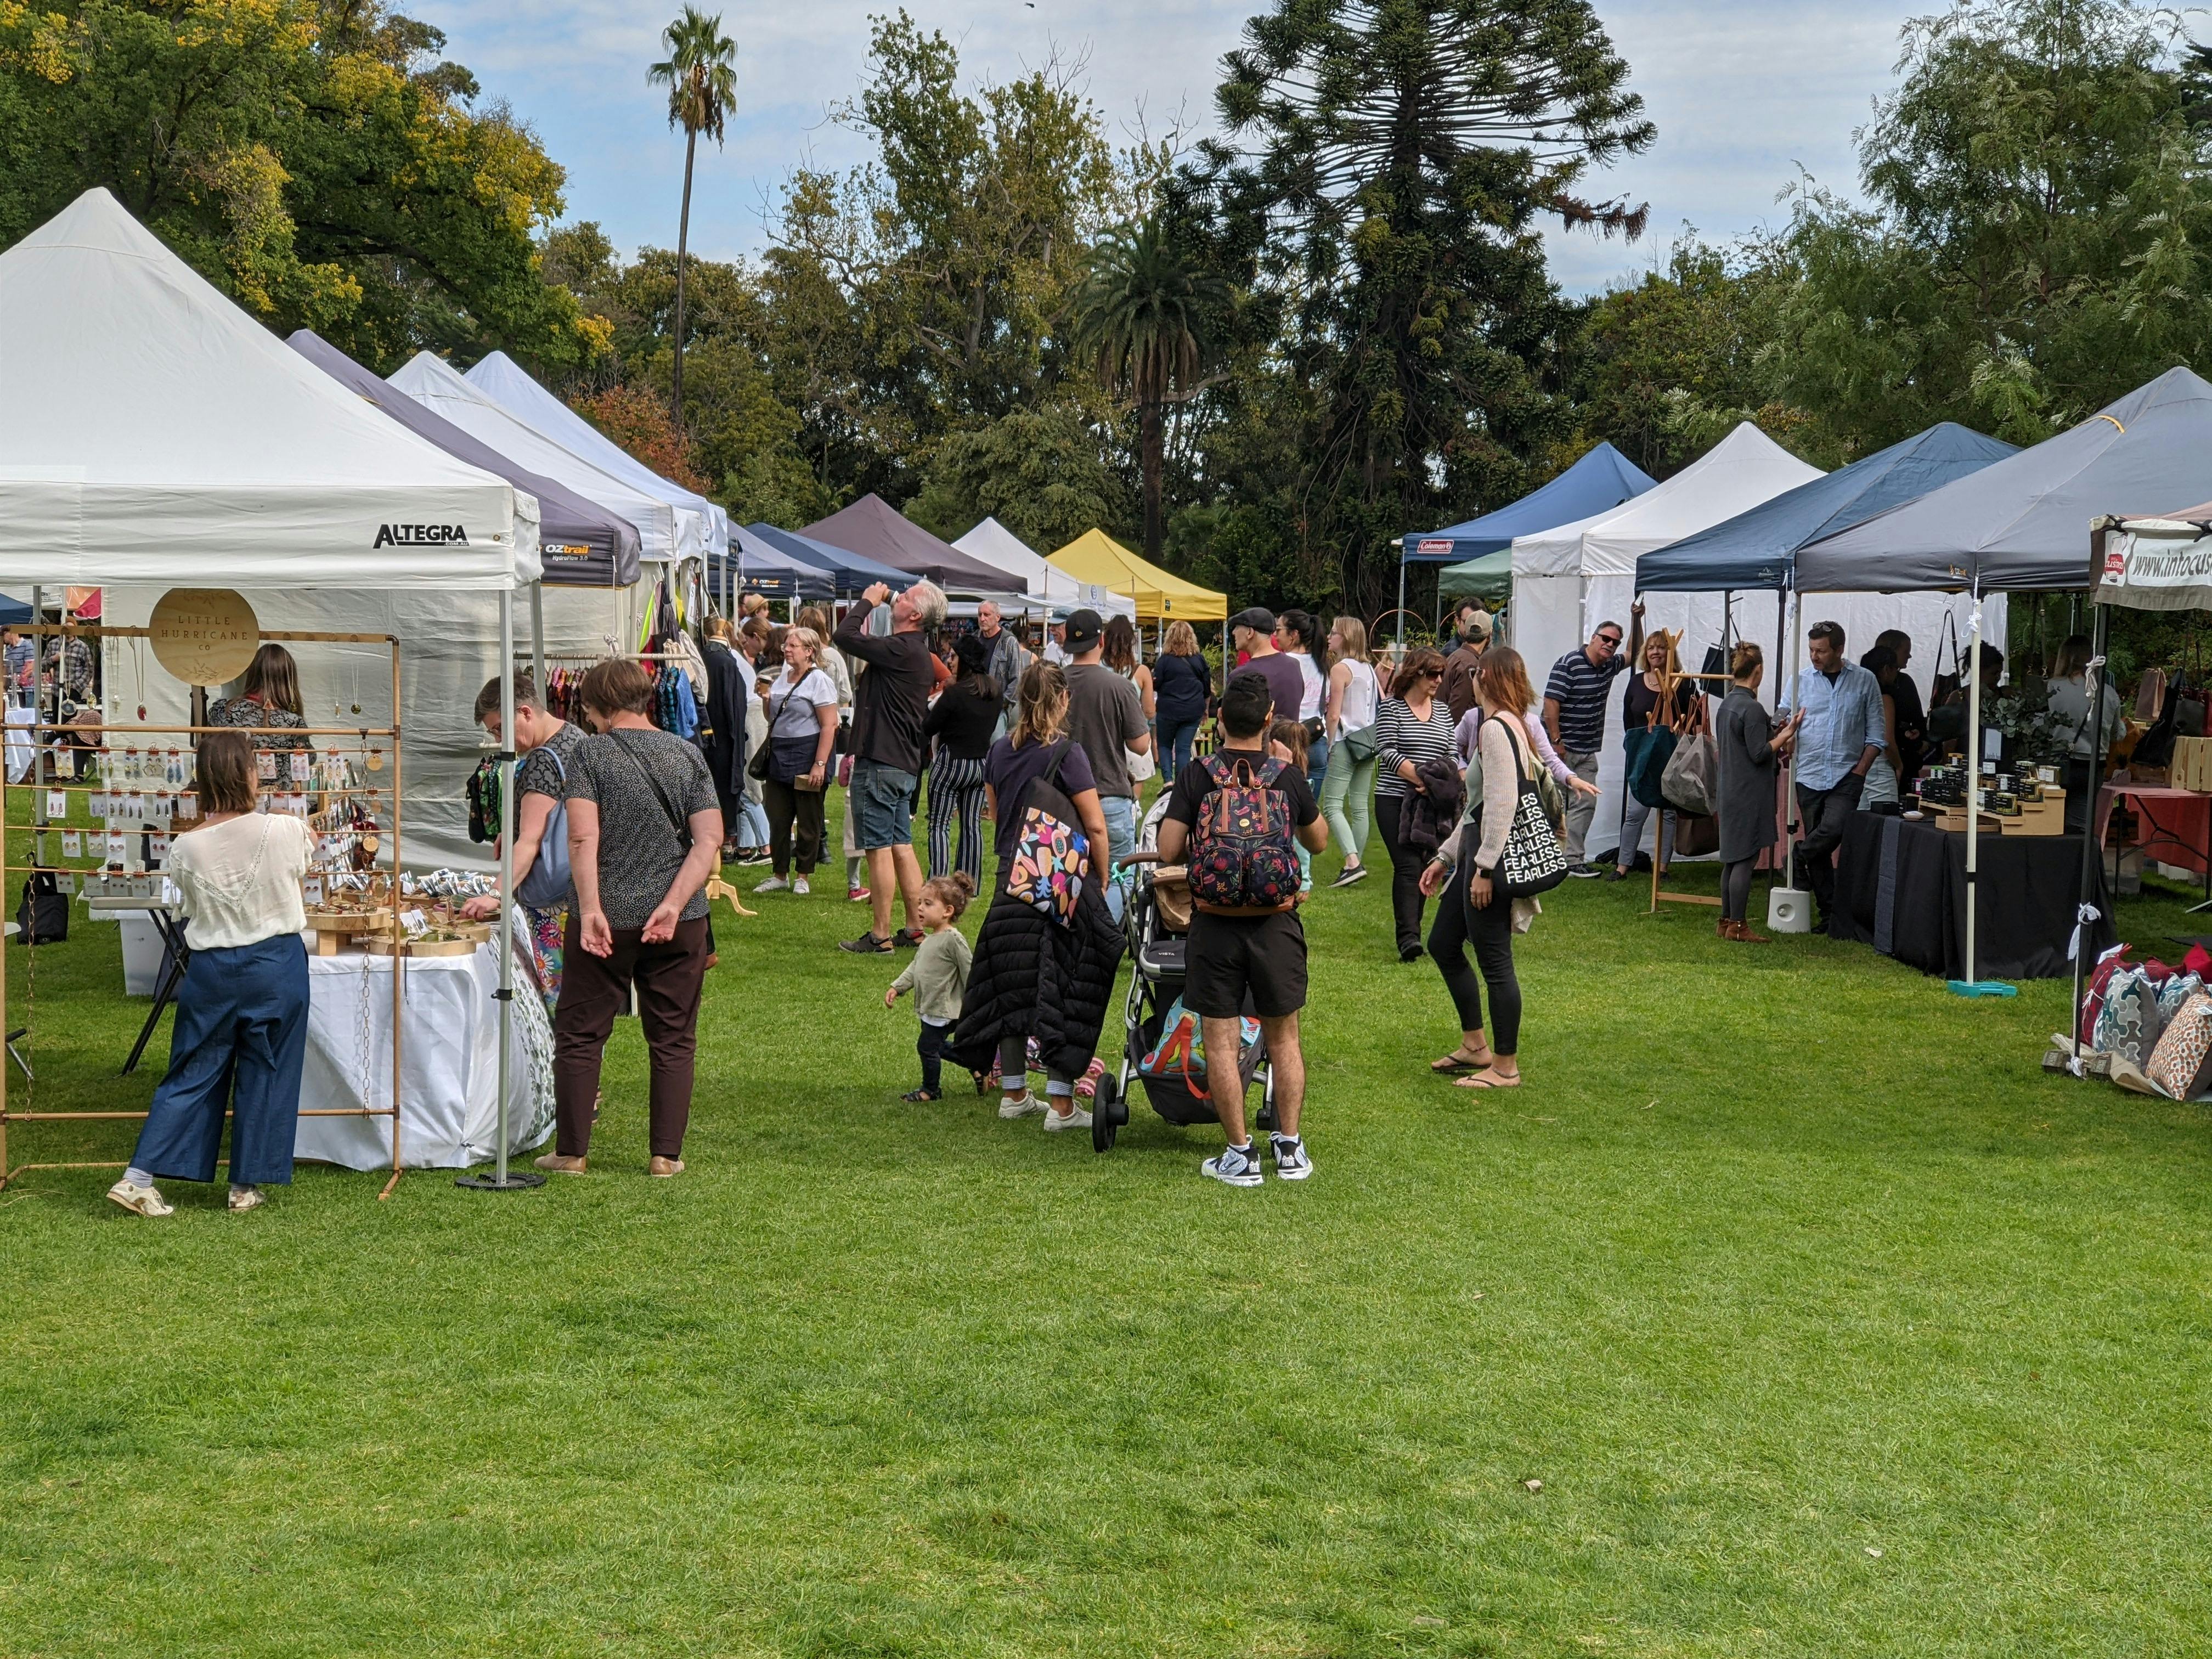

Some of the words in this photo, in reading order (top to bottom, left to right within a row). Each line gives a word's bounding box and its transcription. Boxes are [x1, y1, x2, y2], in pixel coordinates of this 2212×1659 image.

[373, 524, 468, 549] ALTEGRA
[1420, 541, 1446, 549] Coleman
[545, 544, 589, 554] OZtrail
[2132, 549, 2212, 577] www.intocus
[178, 616, 230, 625] LITTLE
[161, 630, 247, 640] HURRICANE
[1504, 844, 1562, 871] FEARLESS
[1506, 857, 1567, 884] FEARLESS
